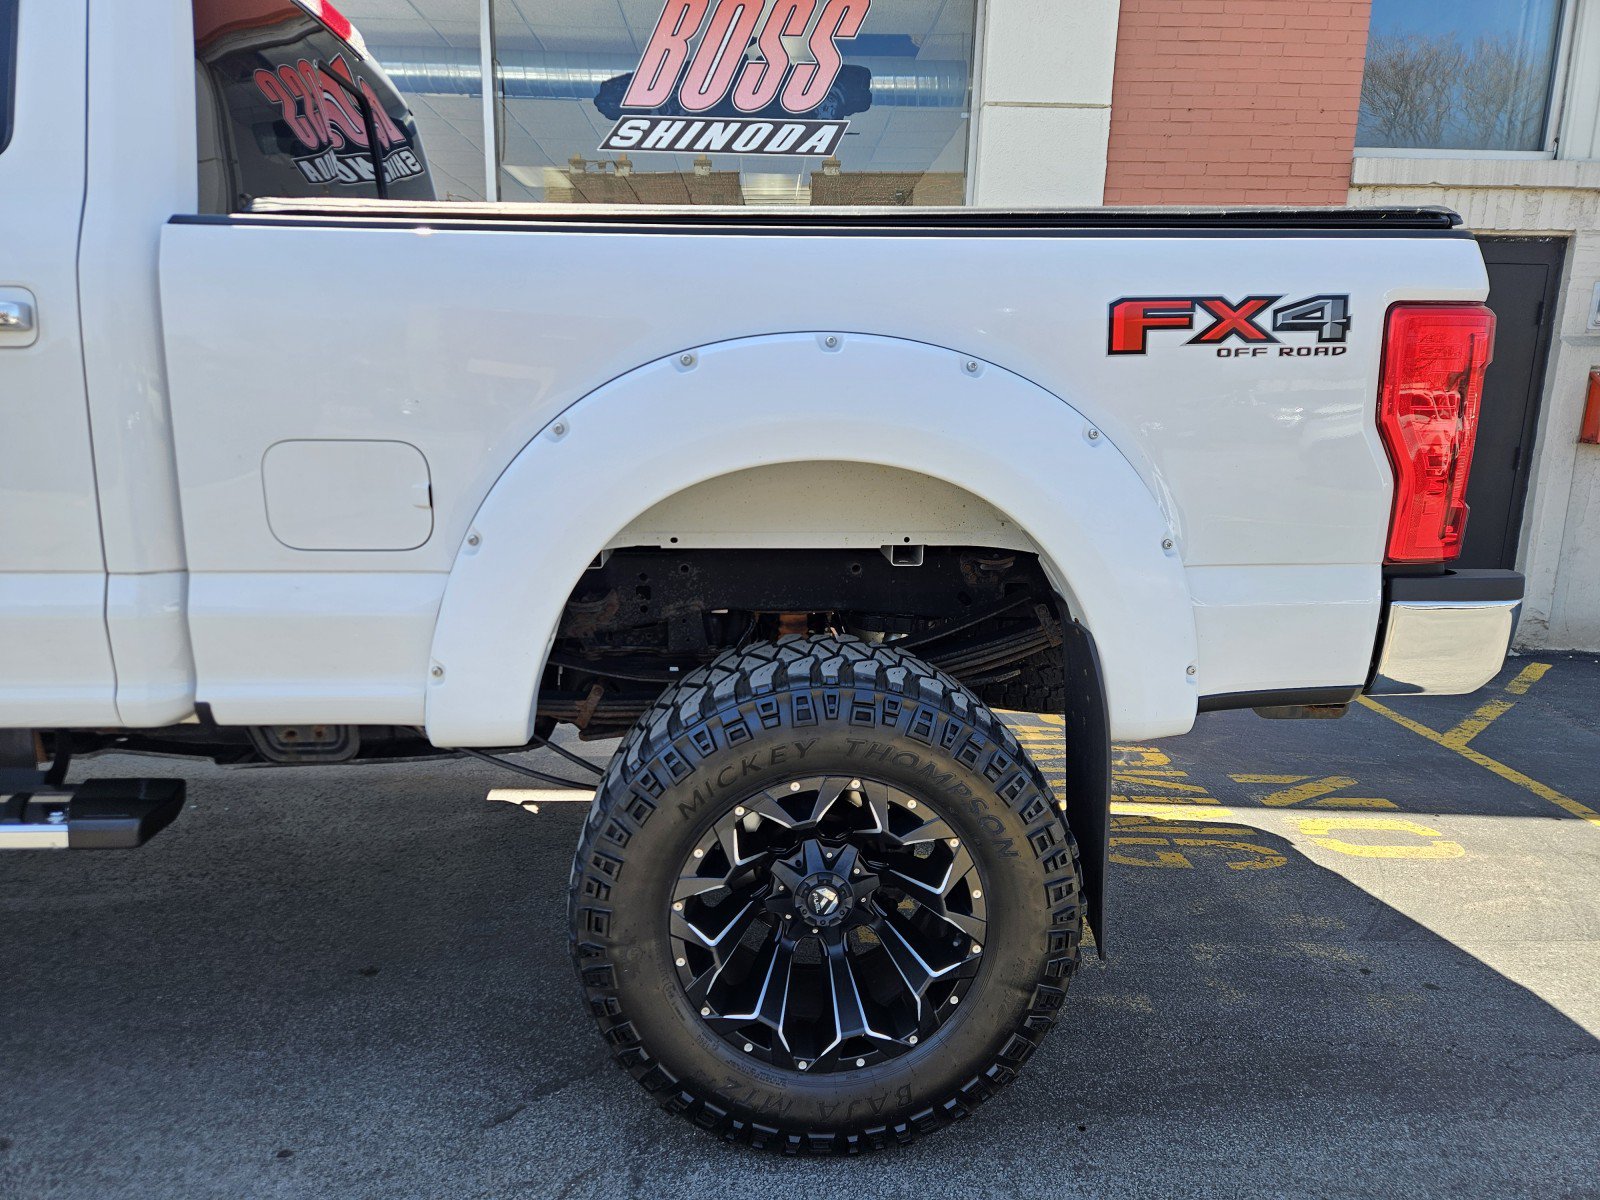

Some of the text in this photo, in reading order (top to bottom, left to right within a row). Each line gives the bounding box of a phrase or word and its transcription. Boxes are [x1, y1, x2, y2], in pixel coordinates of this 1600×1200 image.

[621, 0, 872, 113] BOSS
[608, 119, 840, 154] SHINODA
[1106, 293, 1353, 356] FX4
[1216, 345, 1348, 358] OFF ROAD
[677, 737, 1020, 858] MICKEY THOMPSON
[1226, 773, 1466, 861] NO
